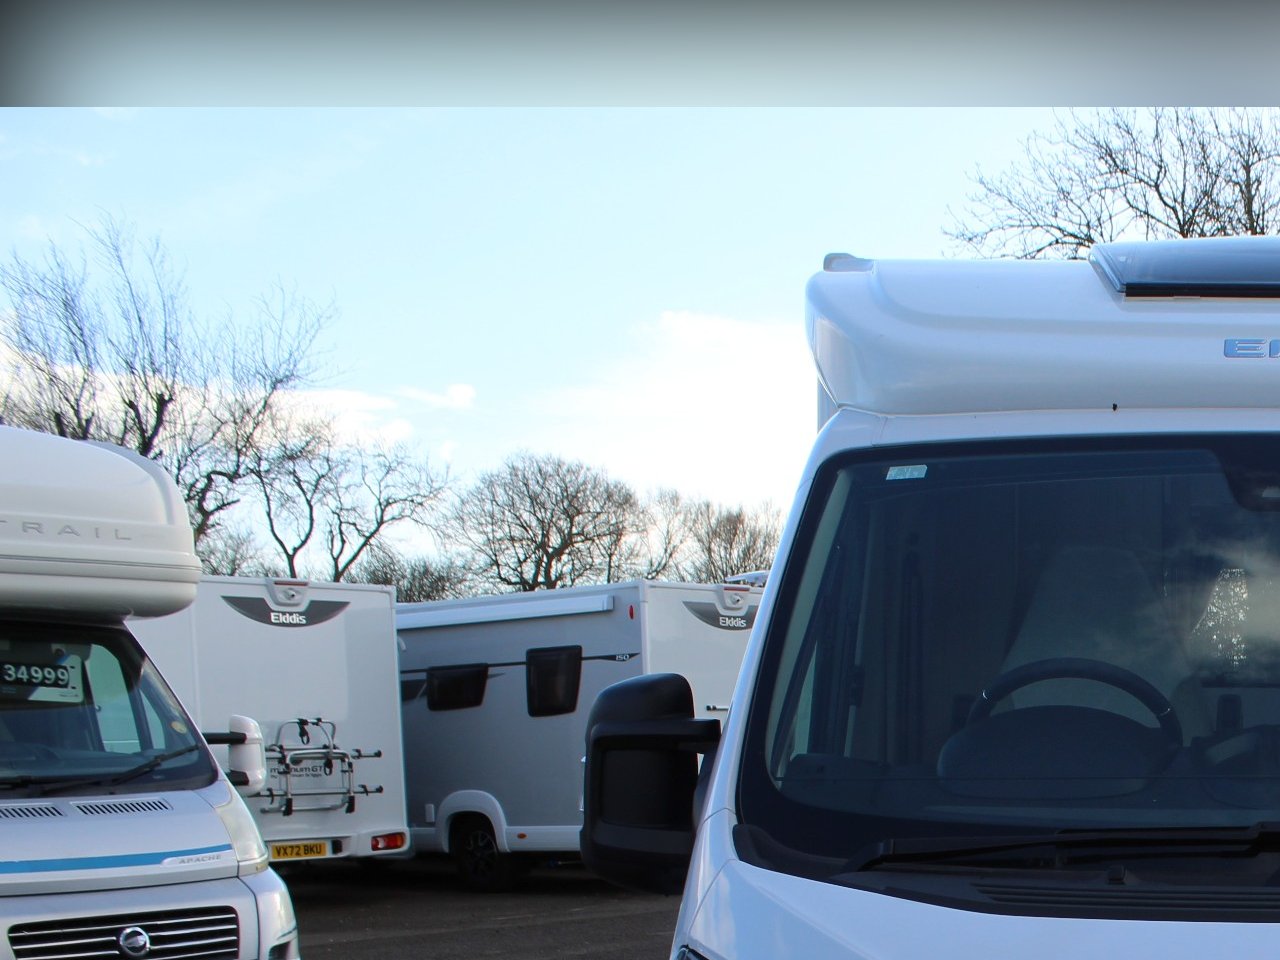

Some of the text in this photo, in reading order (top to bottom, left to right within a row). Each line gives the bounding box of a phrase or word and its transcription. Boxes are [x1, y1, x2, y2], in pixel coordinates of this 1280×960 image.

[270, 612, 307, 624] Elddis
[719, 616, 746, 628] Elddis
[3, 664, 69, 685] 34999
[275, 844, 321, 857] VX72 BKU
[179, 854, 222, 865] APACHE
